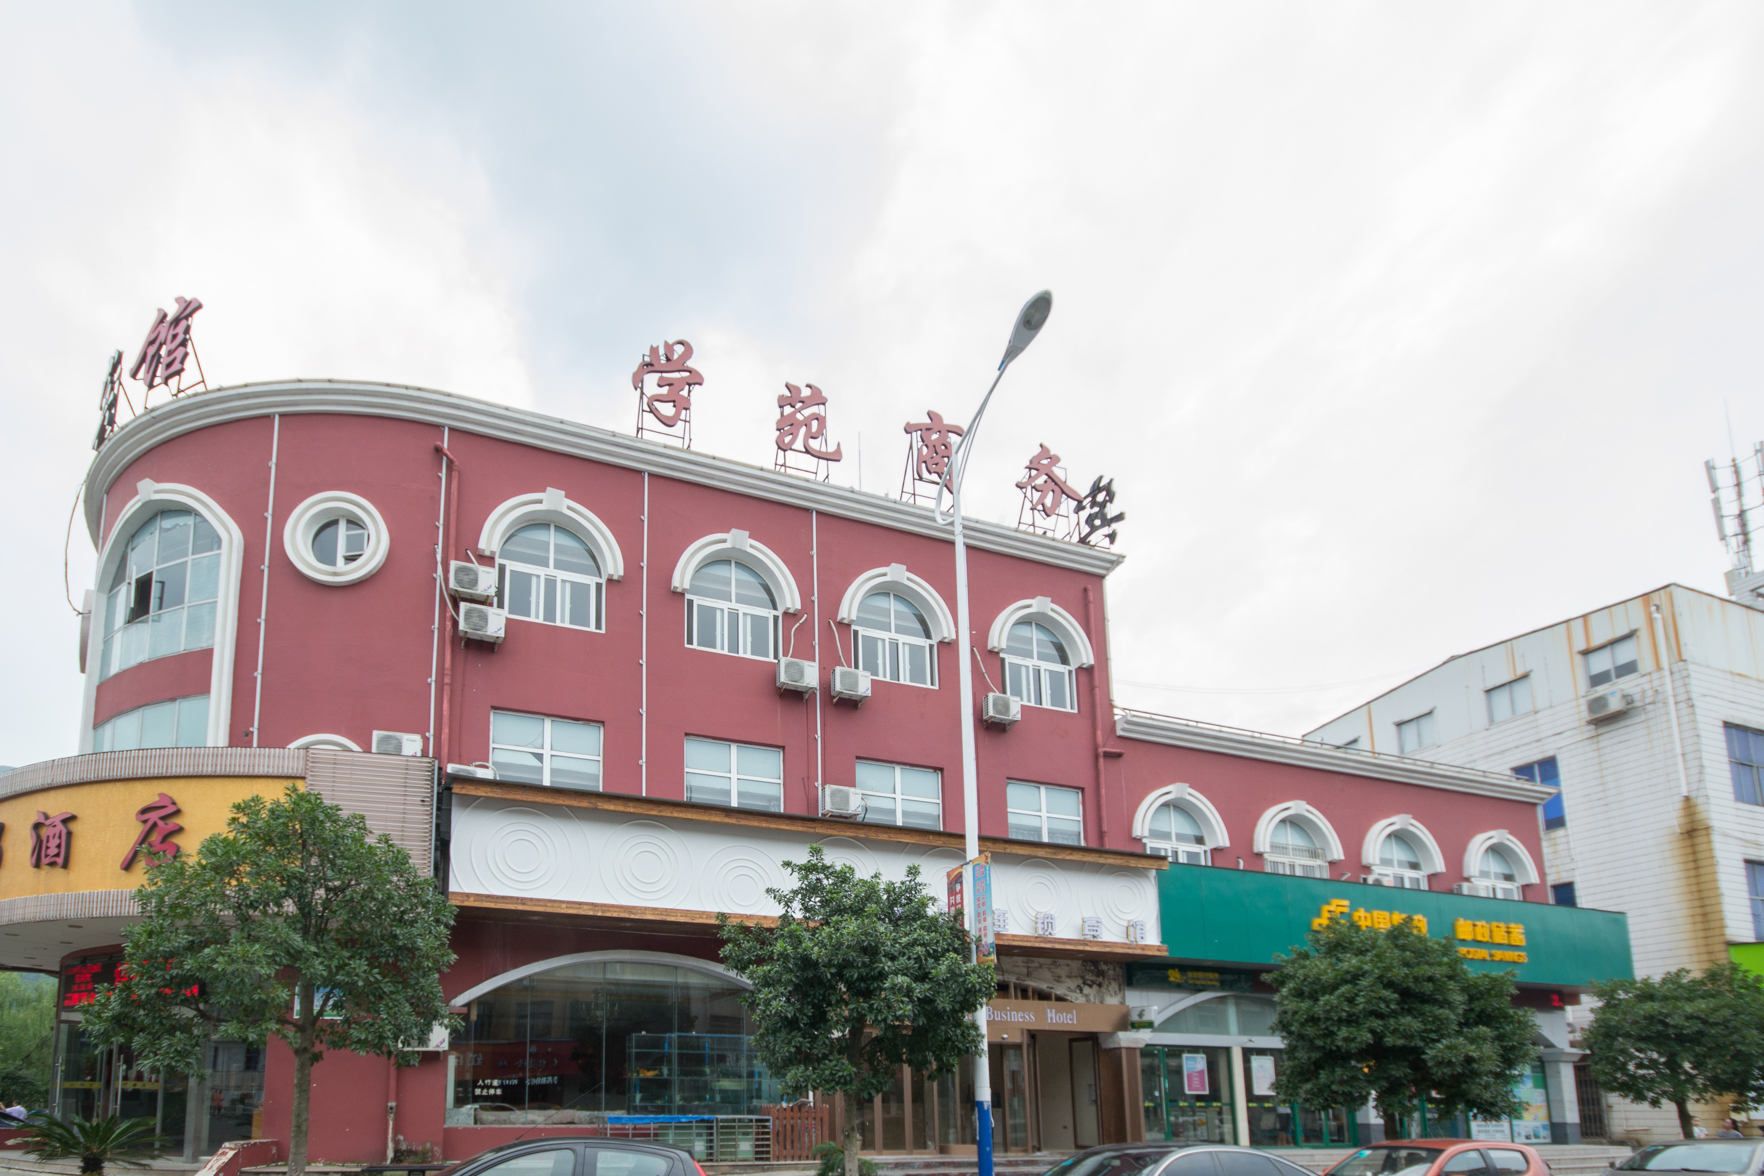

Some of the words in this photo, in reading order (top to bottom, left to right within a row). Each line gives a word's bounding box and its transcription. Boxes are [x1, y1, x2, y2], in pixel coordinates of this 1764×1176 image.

[632, 338, 1084, 517] 学苑商务
[0, 793, 185, 872] 酒店
[938, 905, 1147, 943] 连锁宾馆
[1454, 918, 1527, 946] 邮政储蓄
[986, 1006, 1036, 1022] Business
[1047, 1009, 1077, 1024] Hotel
[474, 1088, 503, 1096] 禁止停车
